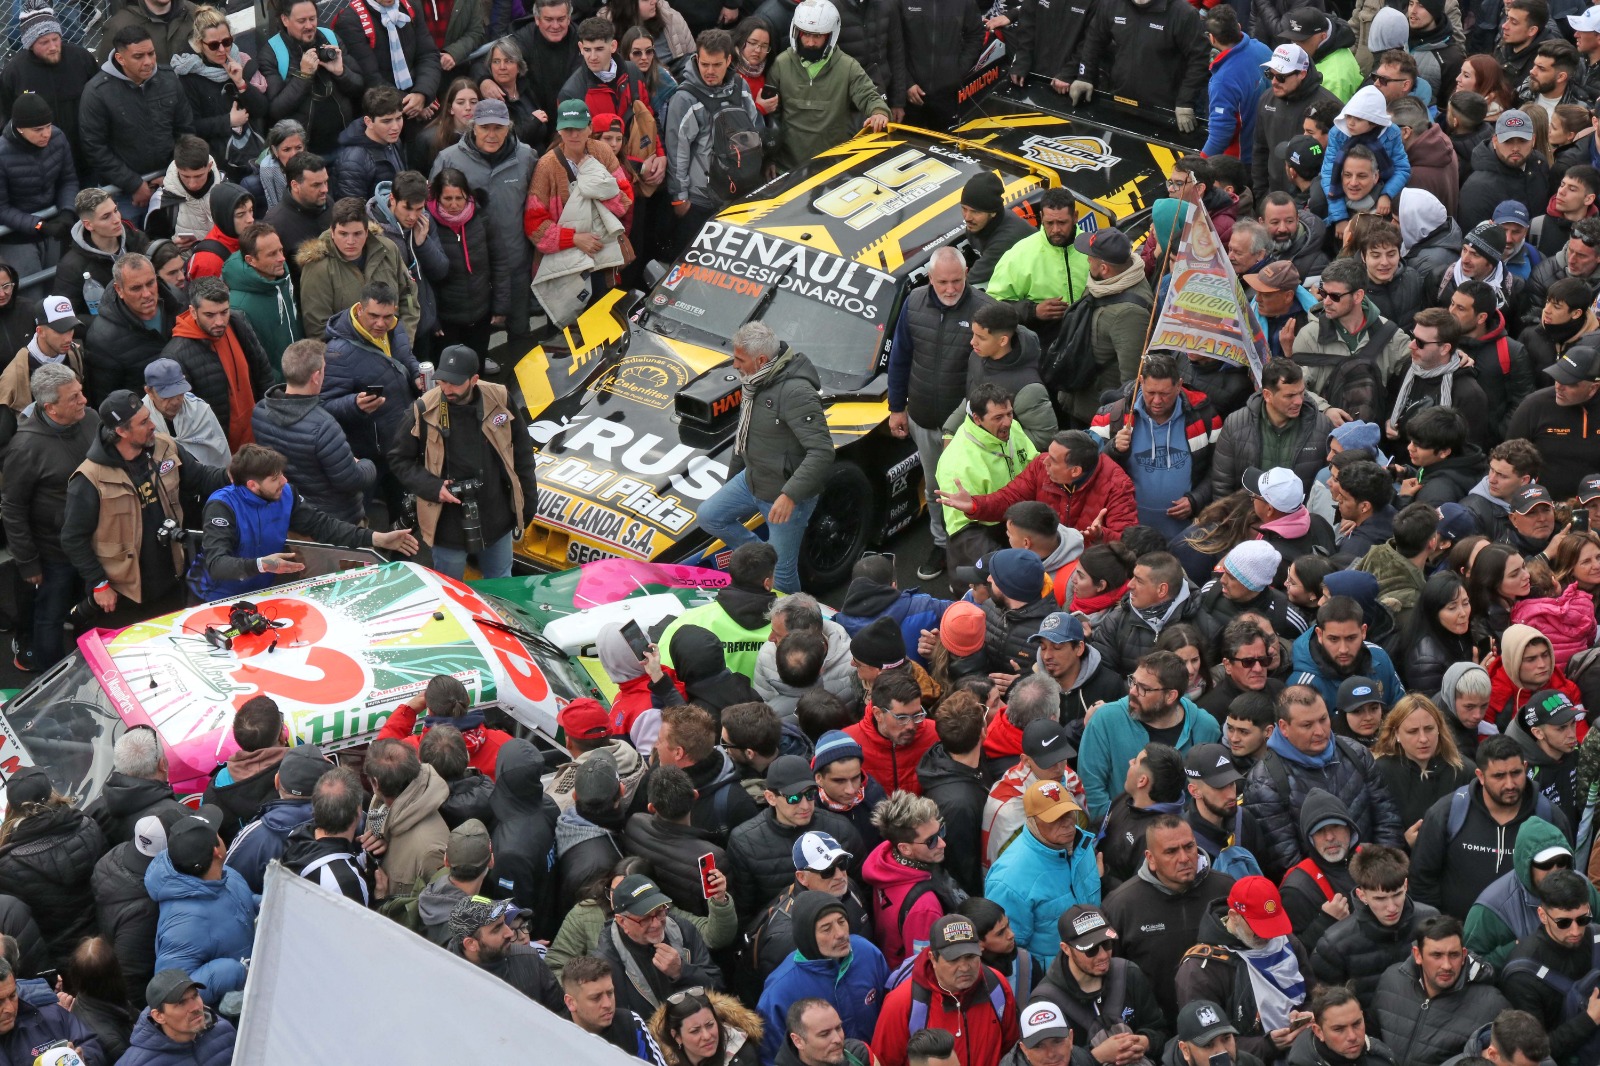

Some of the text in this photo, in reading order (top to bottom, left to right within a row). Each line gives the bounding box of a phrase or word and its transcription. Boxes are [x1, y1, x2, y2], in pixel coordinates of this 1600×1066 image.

[958, 66, 999, 104] HAMILTON
[813, 149, 962, 231] 95
[679, 262, 764, 298] HAMILTON
[691, 221, 896, 301] RENAULT
[684, 250, 878, 319] CONCESIONARIOS
[878, 351, 890, 367] TC
[563, 417, 730, 500] RUS
[549, 459, 695, 533] Del Plata
[568, 500, 624, 542] LANDA
[721, 641, 766, 654] PREVENC
[369, 680, 415, 699] CARLITOS
[1462, 842, 1492, 853] TOMMY
